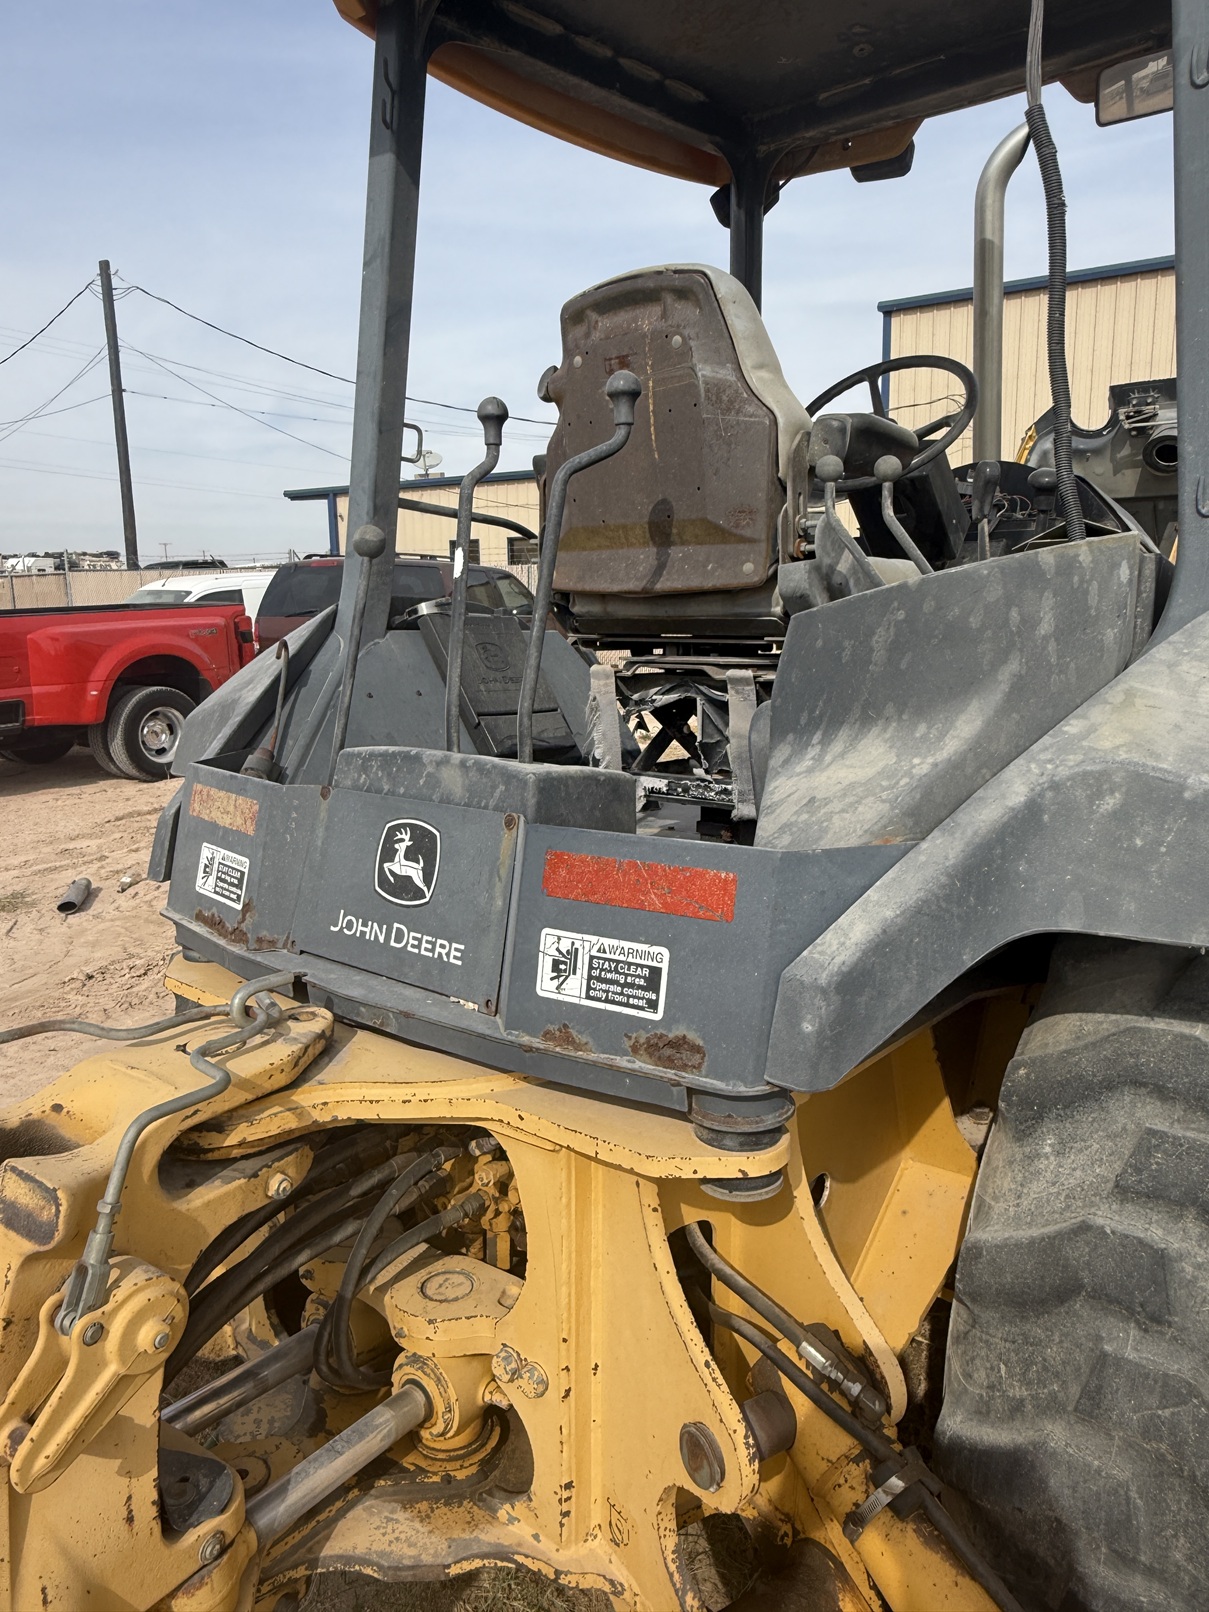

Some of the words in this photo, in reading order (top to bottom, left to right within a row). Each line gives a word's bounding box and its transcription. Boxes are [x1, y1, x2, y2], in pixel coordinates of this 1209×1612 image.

[330, 909, 387, 944] JOHN
[389, 922, 465, 966] DEERE
[608, 943, 664, 964] WARNING
[591, 968, 600, 976] of
[600, 971, 625, 983] swing
[626, 976, 647, 986] area.
[592, 958, 616, 971] STAY
[617, 963, 650, 978] CLEAR
[589, 989, 606, 1000] only
[608, 991, 627, 1003] from
[628, 997, 648, 1007] seat.
[590, 979, 622, 992] Operate
[623, 987, 657, 1000] controls
